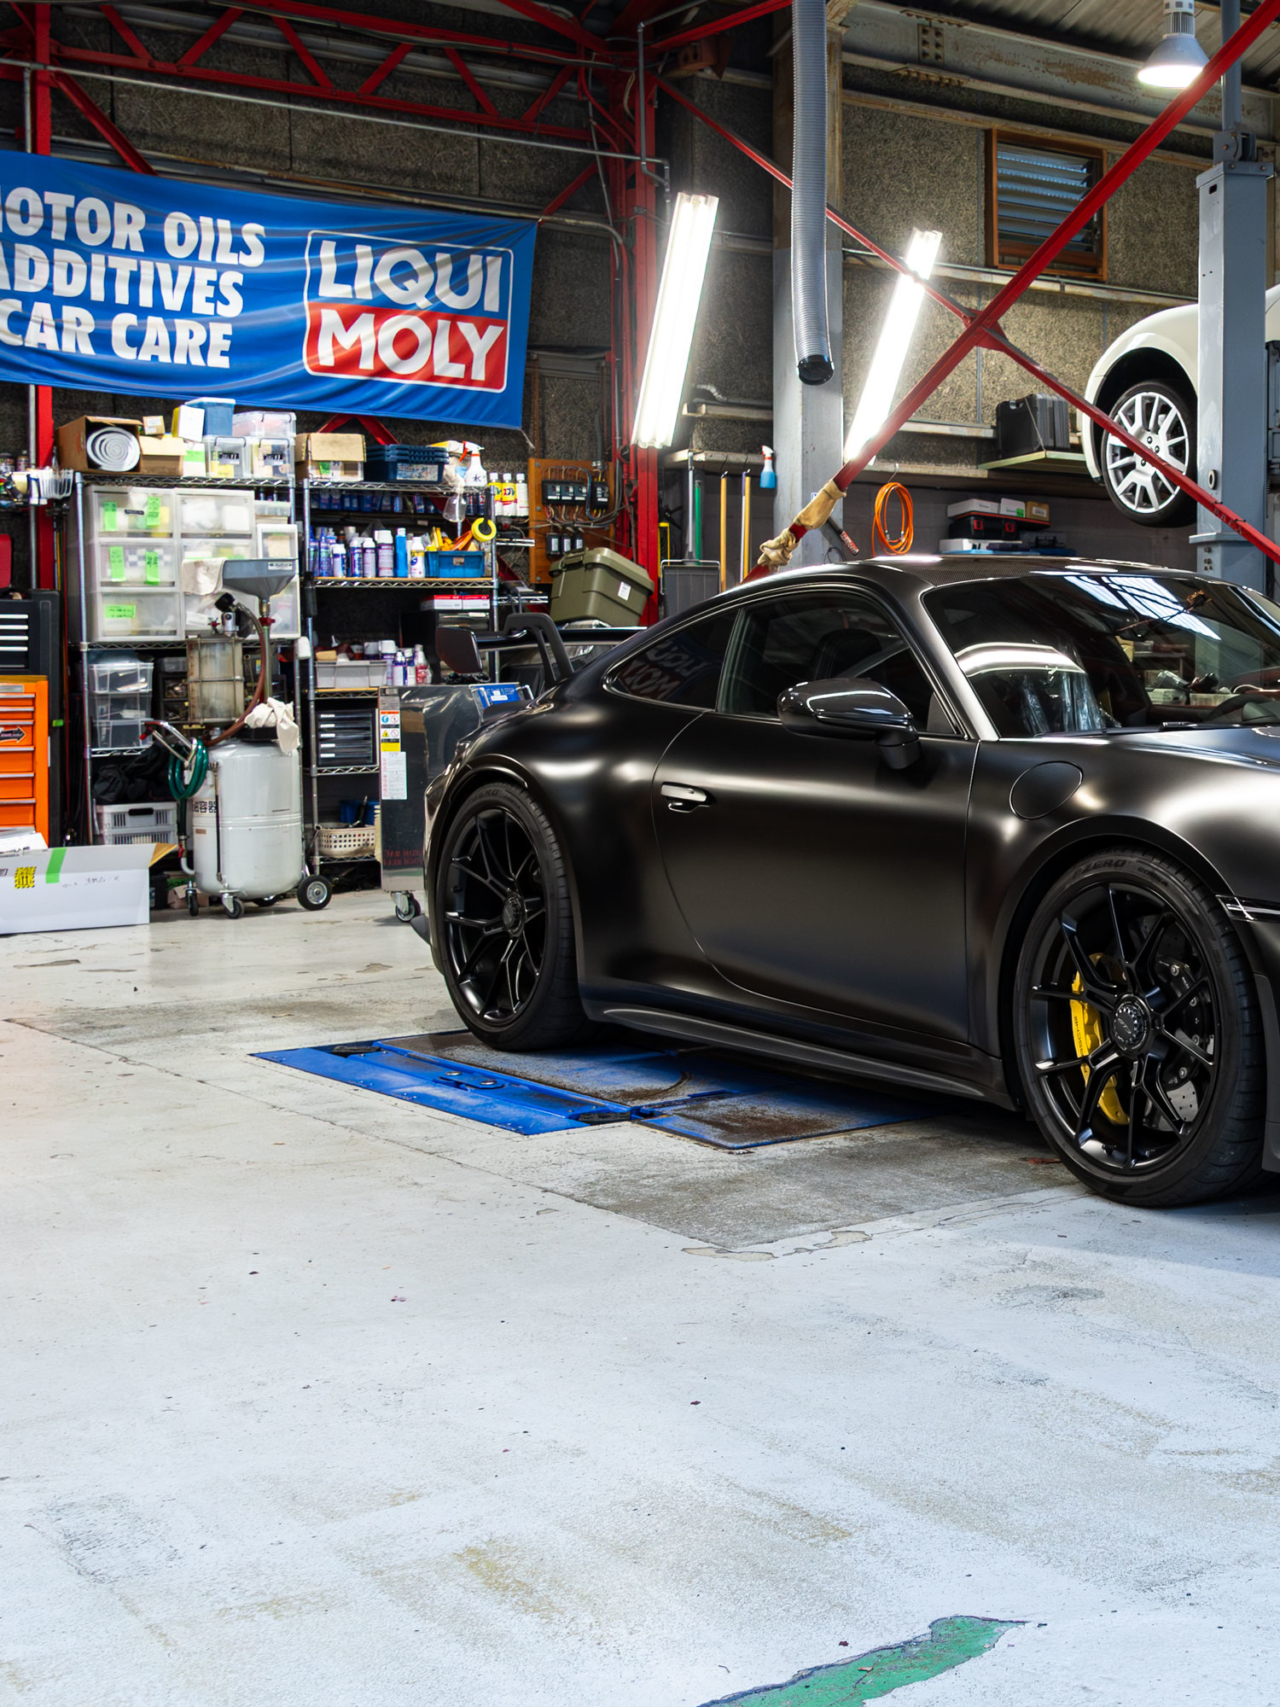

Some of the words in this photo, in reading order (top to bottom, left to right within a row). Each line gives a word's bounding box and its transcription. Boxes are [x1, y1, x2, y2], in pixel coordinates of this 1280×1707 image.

[0, 186, 146, 252] OTOR
[163, 211, 266, 267] OILS
[318, 240, 502, 312] LIQUI
[0, 298, 96, 356] CAR
[111, 312, 233, 369] CARE
[317, 308, 505, 381] MOLY
